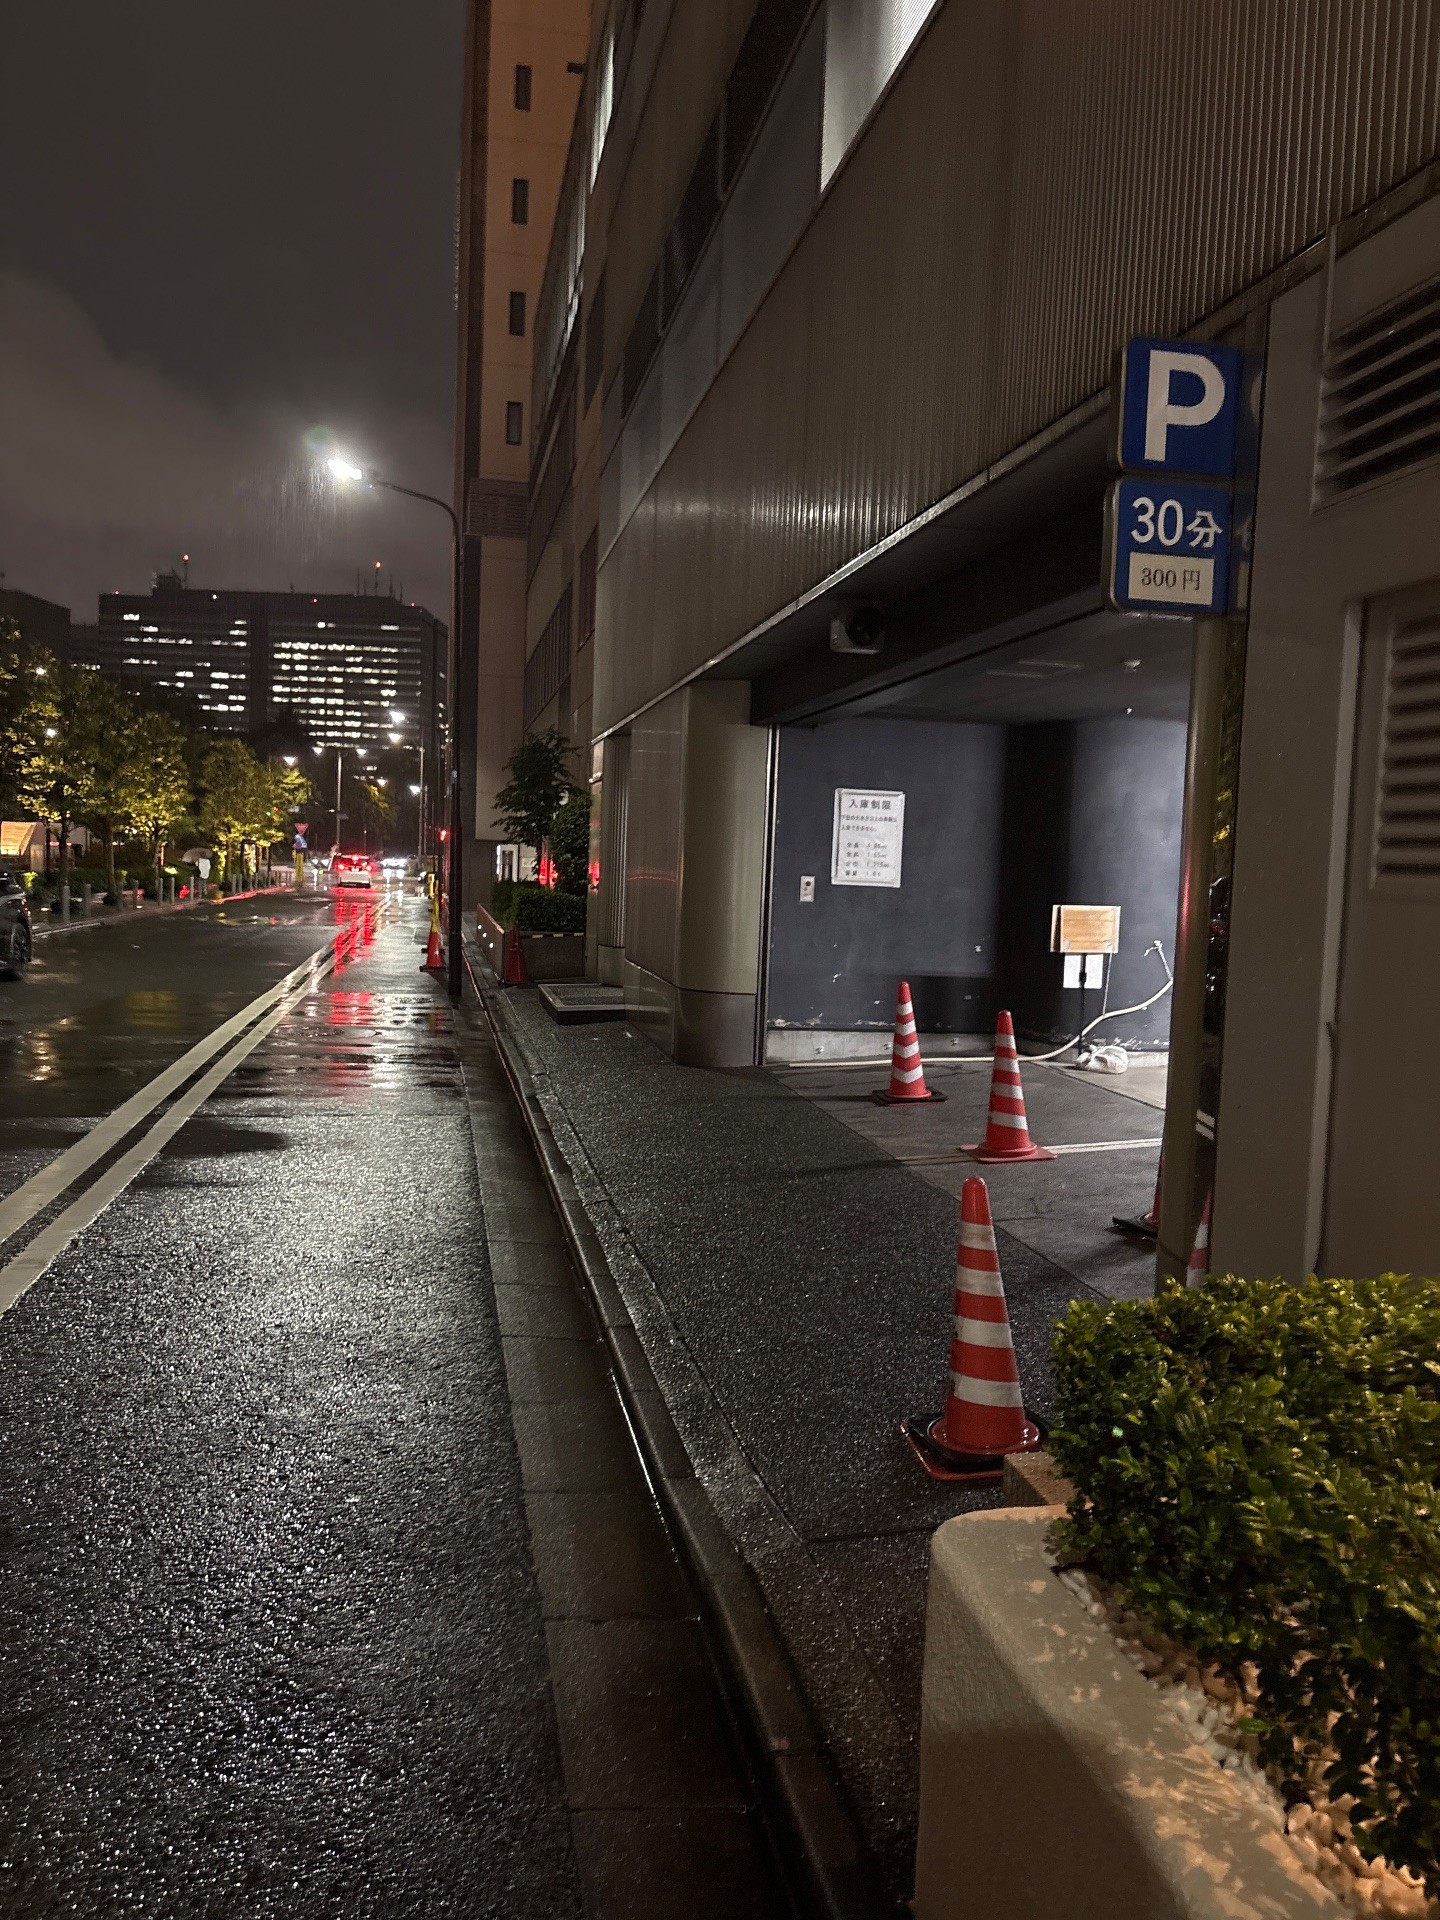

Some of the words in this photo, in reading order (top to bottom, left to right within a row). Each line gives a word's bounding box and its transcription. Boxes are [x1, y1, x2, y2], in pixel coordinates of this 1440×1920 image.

[1144, 349, 1225, 462] P
[1130, 496, 1223, 549] 30分
[849, 798, 891, 810] 入庫制限
